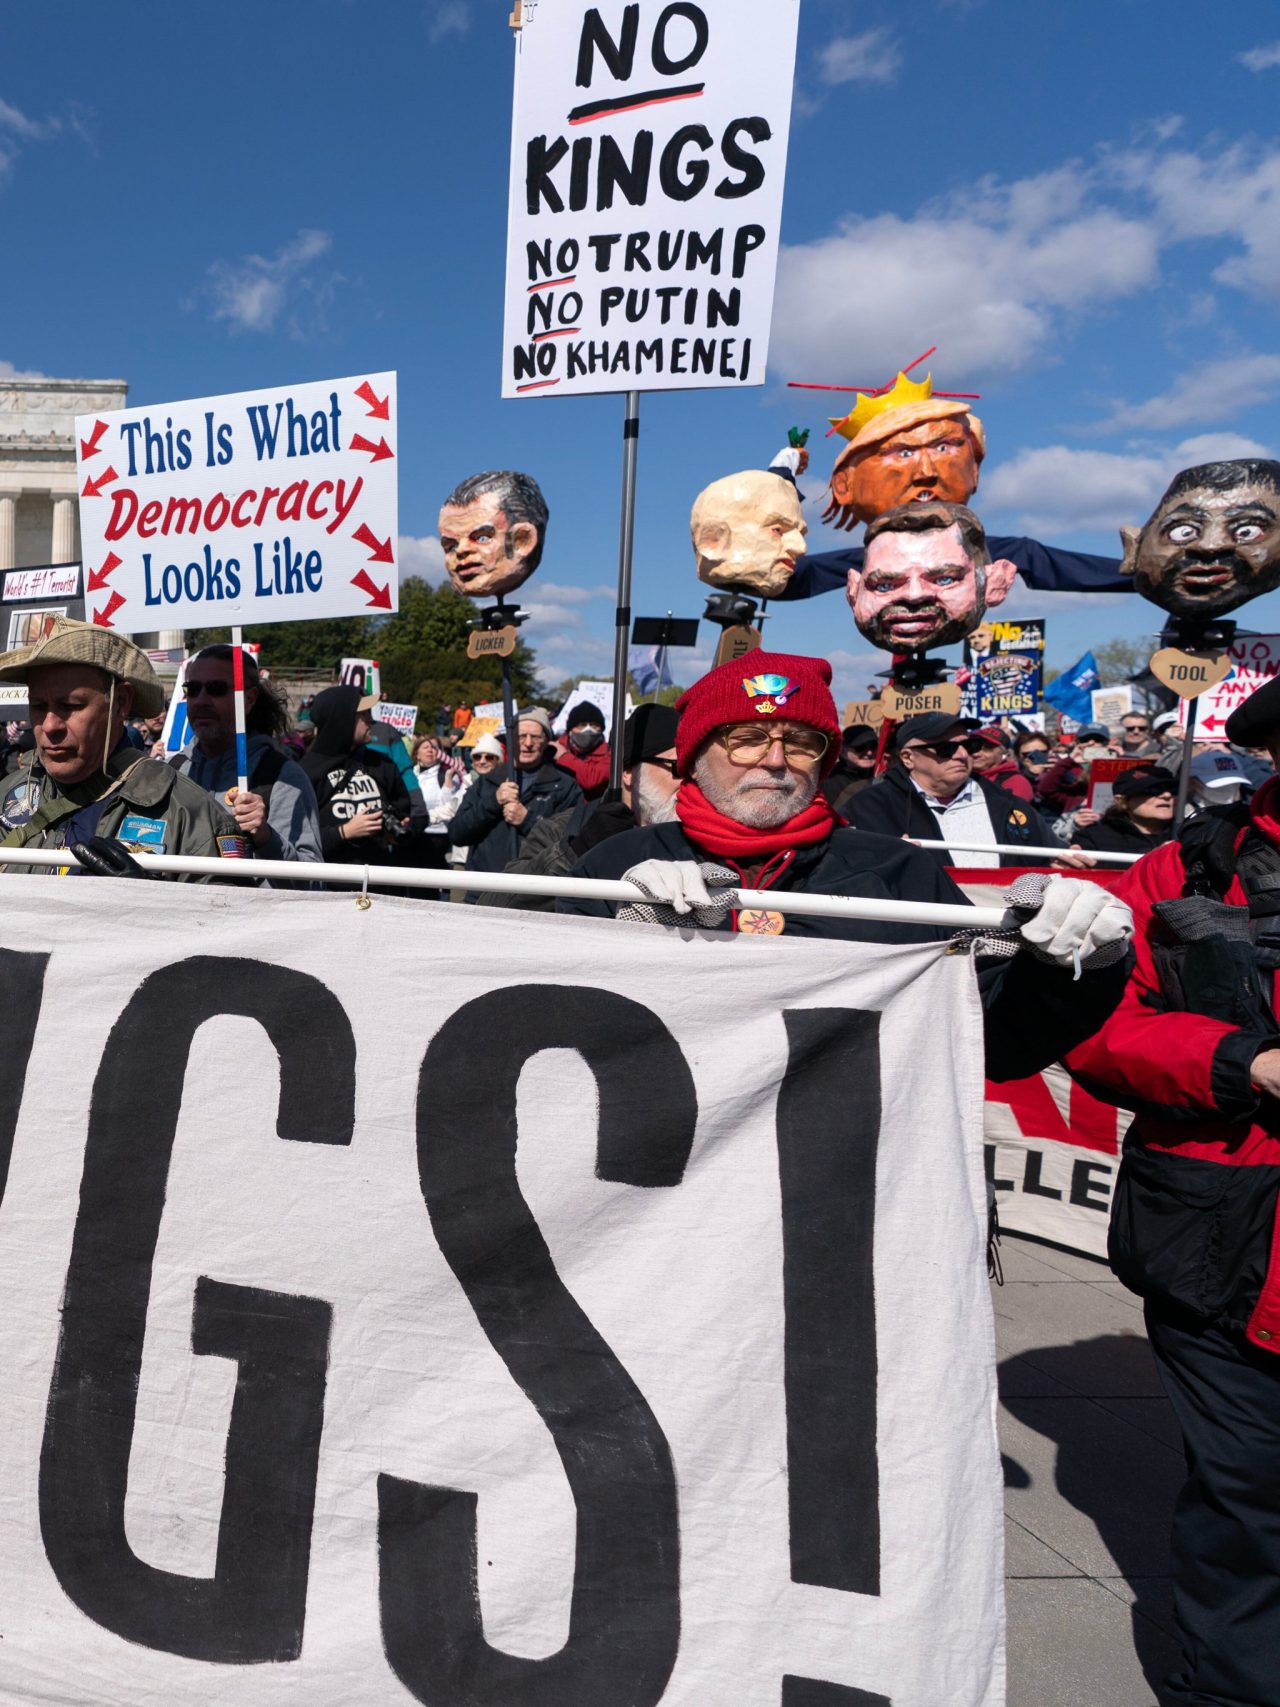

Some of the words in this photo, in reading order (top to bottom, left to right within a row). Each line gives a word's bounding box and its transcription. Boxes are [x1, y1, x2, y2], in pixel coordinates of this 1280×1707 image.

[575, 1, 709, 88] NO
[526, 116, 772, 215] KINGS
[526, 238, 580, 281] NO
[588, 224, 766, 279] TRUMP
[527, 291, 583, 335] NO
[600, 286, 741, 329] PUTIN
[513, 342, 557, 381] NO
[567, 337, 751, 381] KHAMENEI
[120, 416, 192, 477] This
[204, 411, 234, 467] Is
[246, 391, 342, 461] What
[104, 475, 364, 542] Democracy
[142, 543, 241, 606] Looks
[253, 536, 323, 597] Like
[1169, 664, 1208, 682] TOOL
[1226, 641, 1271, 661] NO
[895, 695, 942, 711] POSER
[980, 694, 1034, 711] KINGS
[1218, 681, 1262, 694] ANY
[347, 778, 375, 796] EMI
